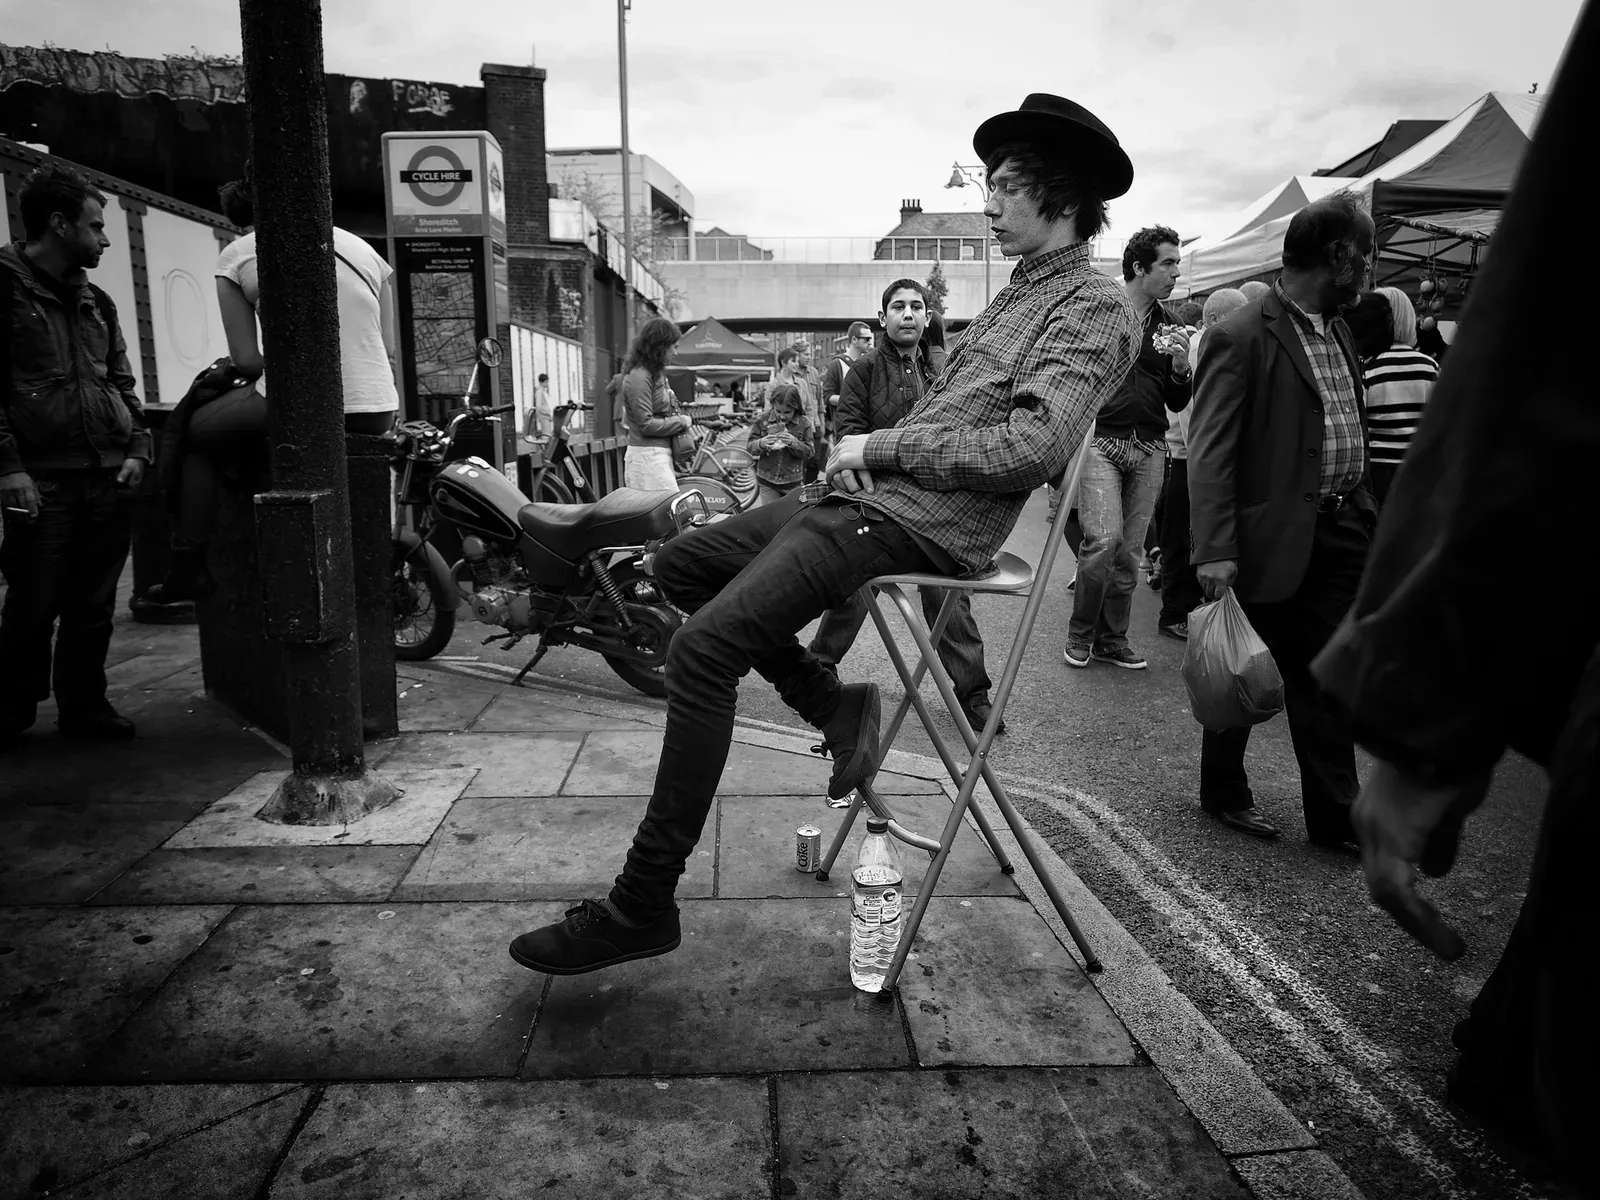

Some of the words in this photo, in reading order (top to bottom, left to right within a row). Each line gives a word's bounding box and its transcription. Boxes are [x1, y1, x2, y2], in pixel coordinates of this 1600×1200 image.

[412, 172, 439, 181] CYCLE
[441, 172, 461, 180] HIRE
[419, 218, 459, 226] Shoreditch
[695, 496, 726, 504] BRCLAYS
[798, 842, 808, 867] Coke
